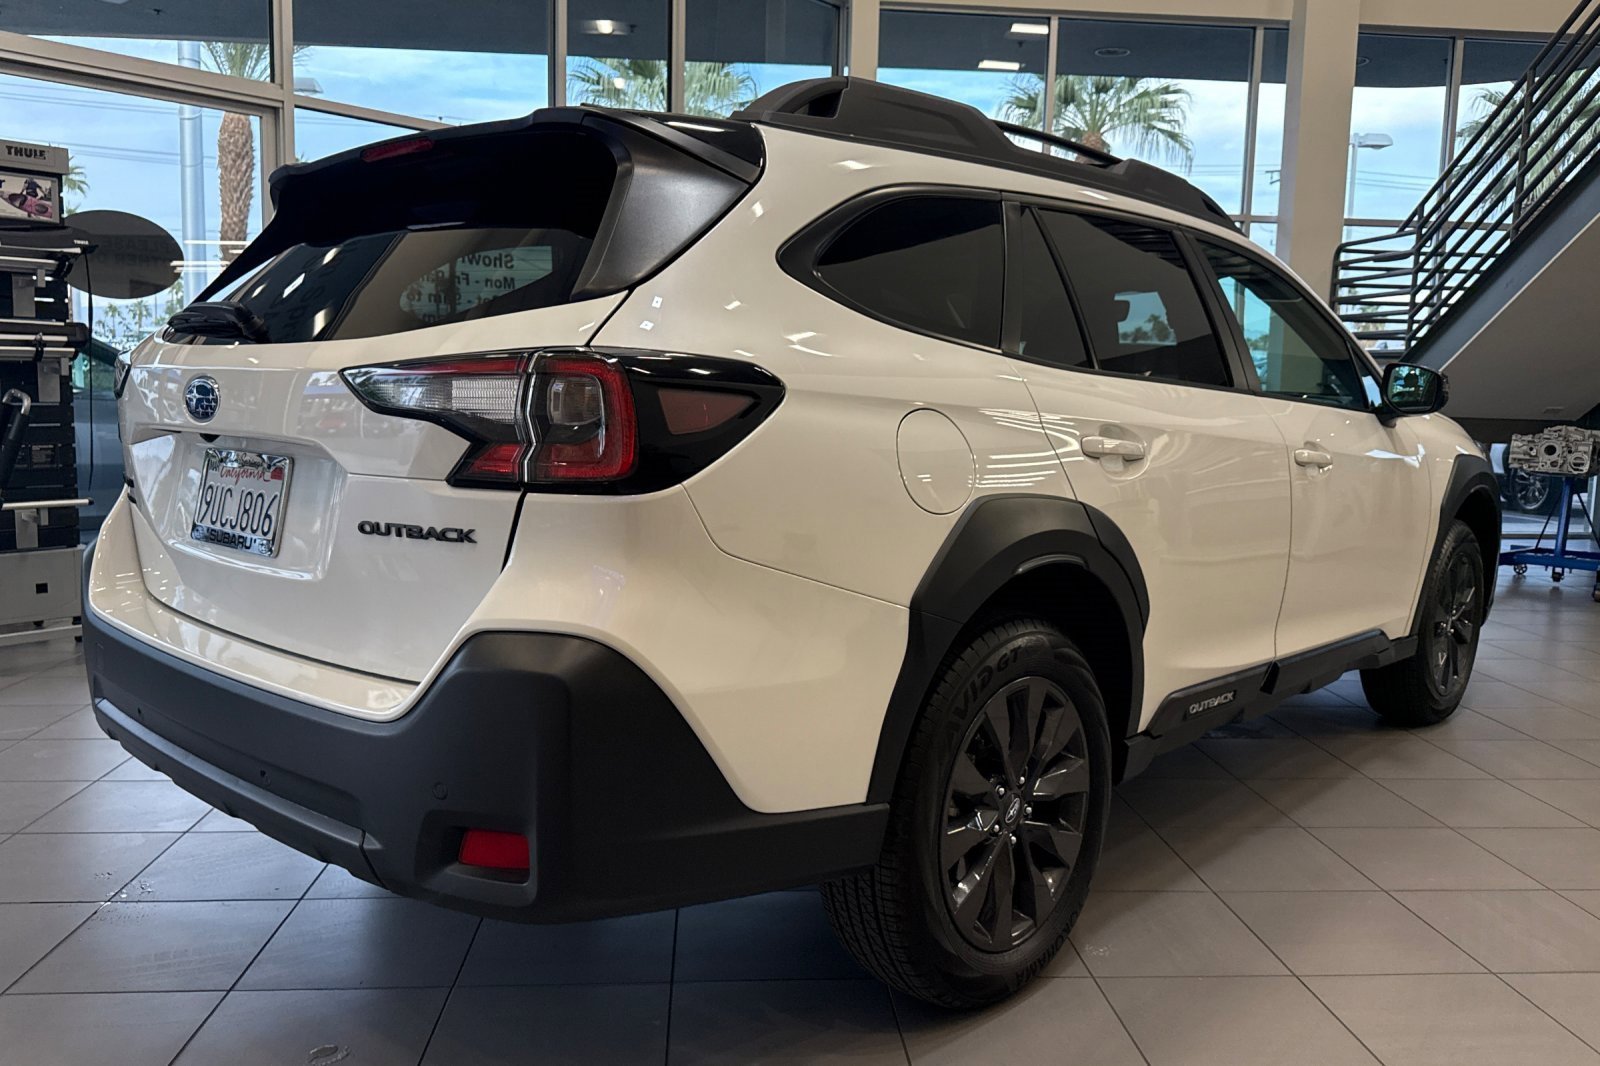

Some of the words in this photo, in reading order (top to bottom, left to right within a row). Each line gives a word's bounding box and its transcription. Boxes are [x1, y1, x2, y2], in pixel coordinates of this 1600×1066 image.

[6, 145, 46, 160] THULE
[220, 466, 270, 485] California
[199, 484, 278, 537] 9UCJ806
[358, 520, 478, 543] OUTBACK
[996, 645, 1022, 672] GT
[1189, 691, 1235, 714] OUTBACK
